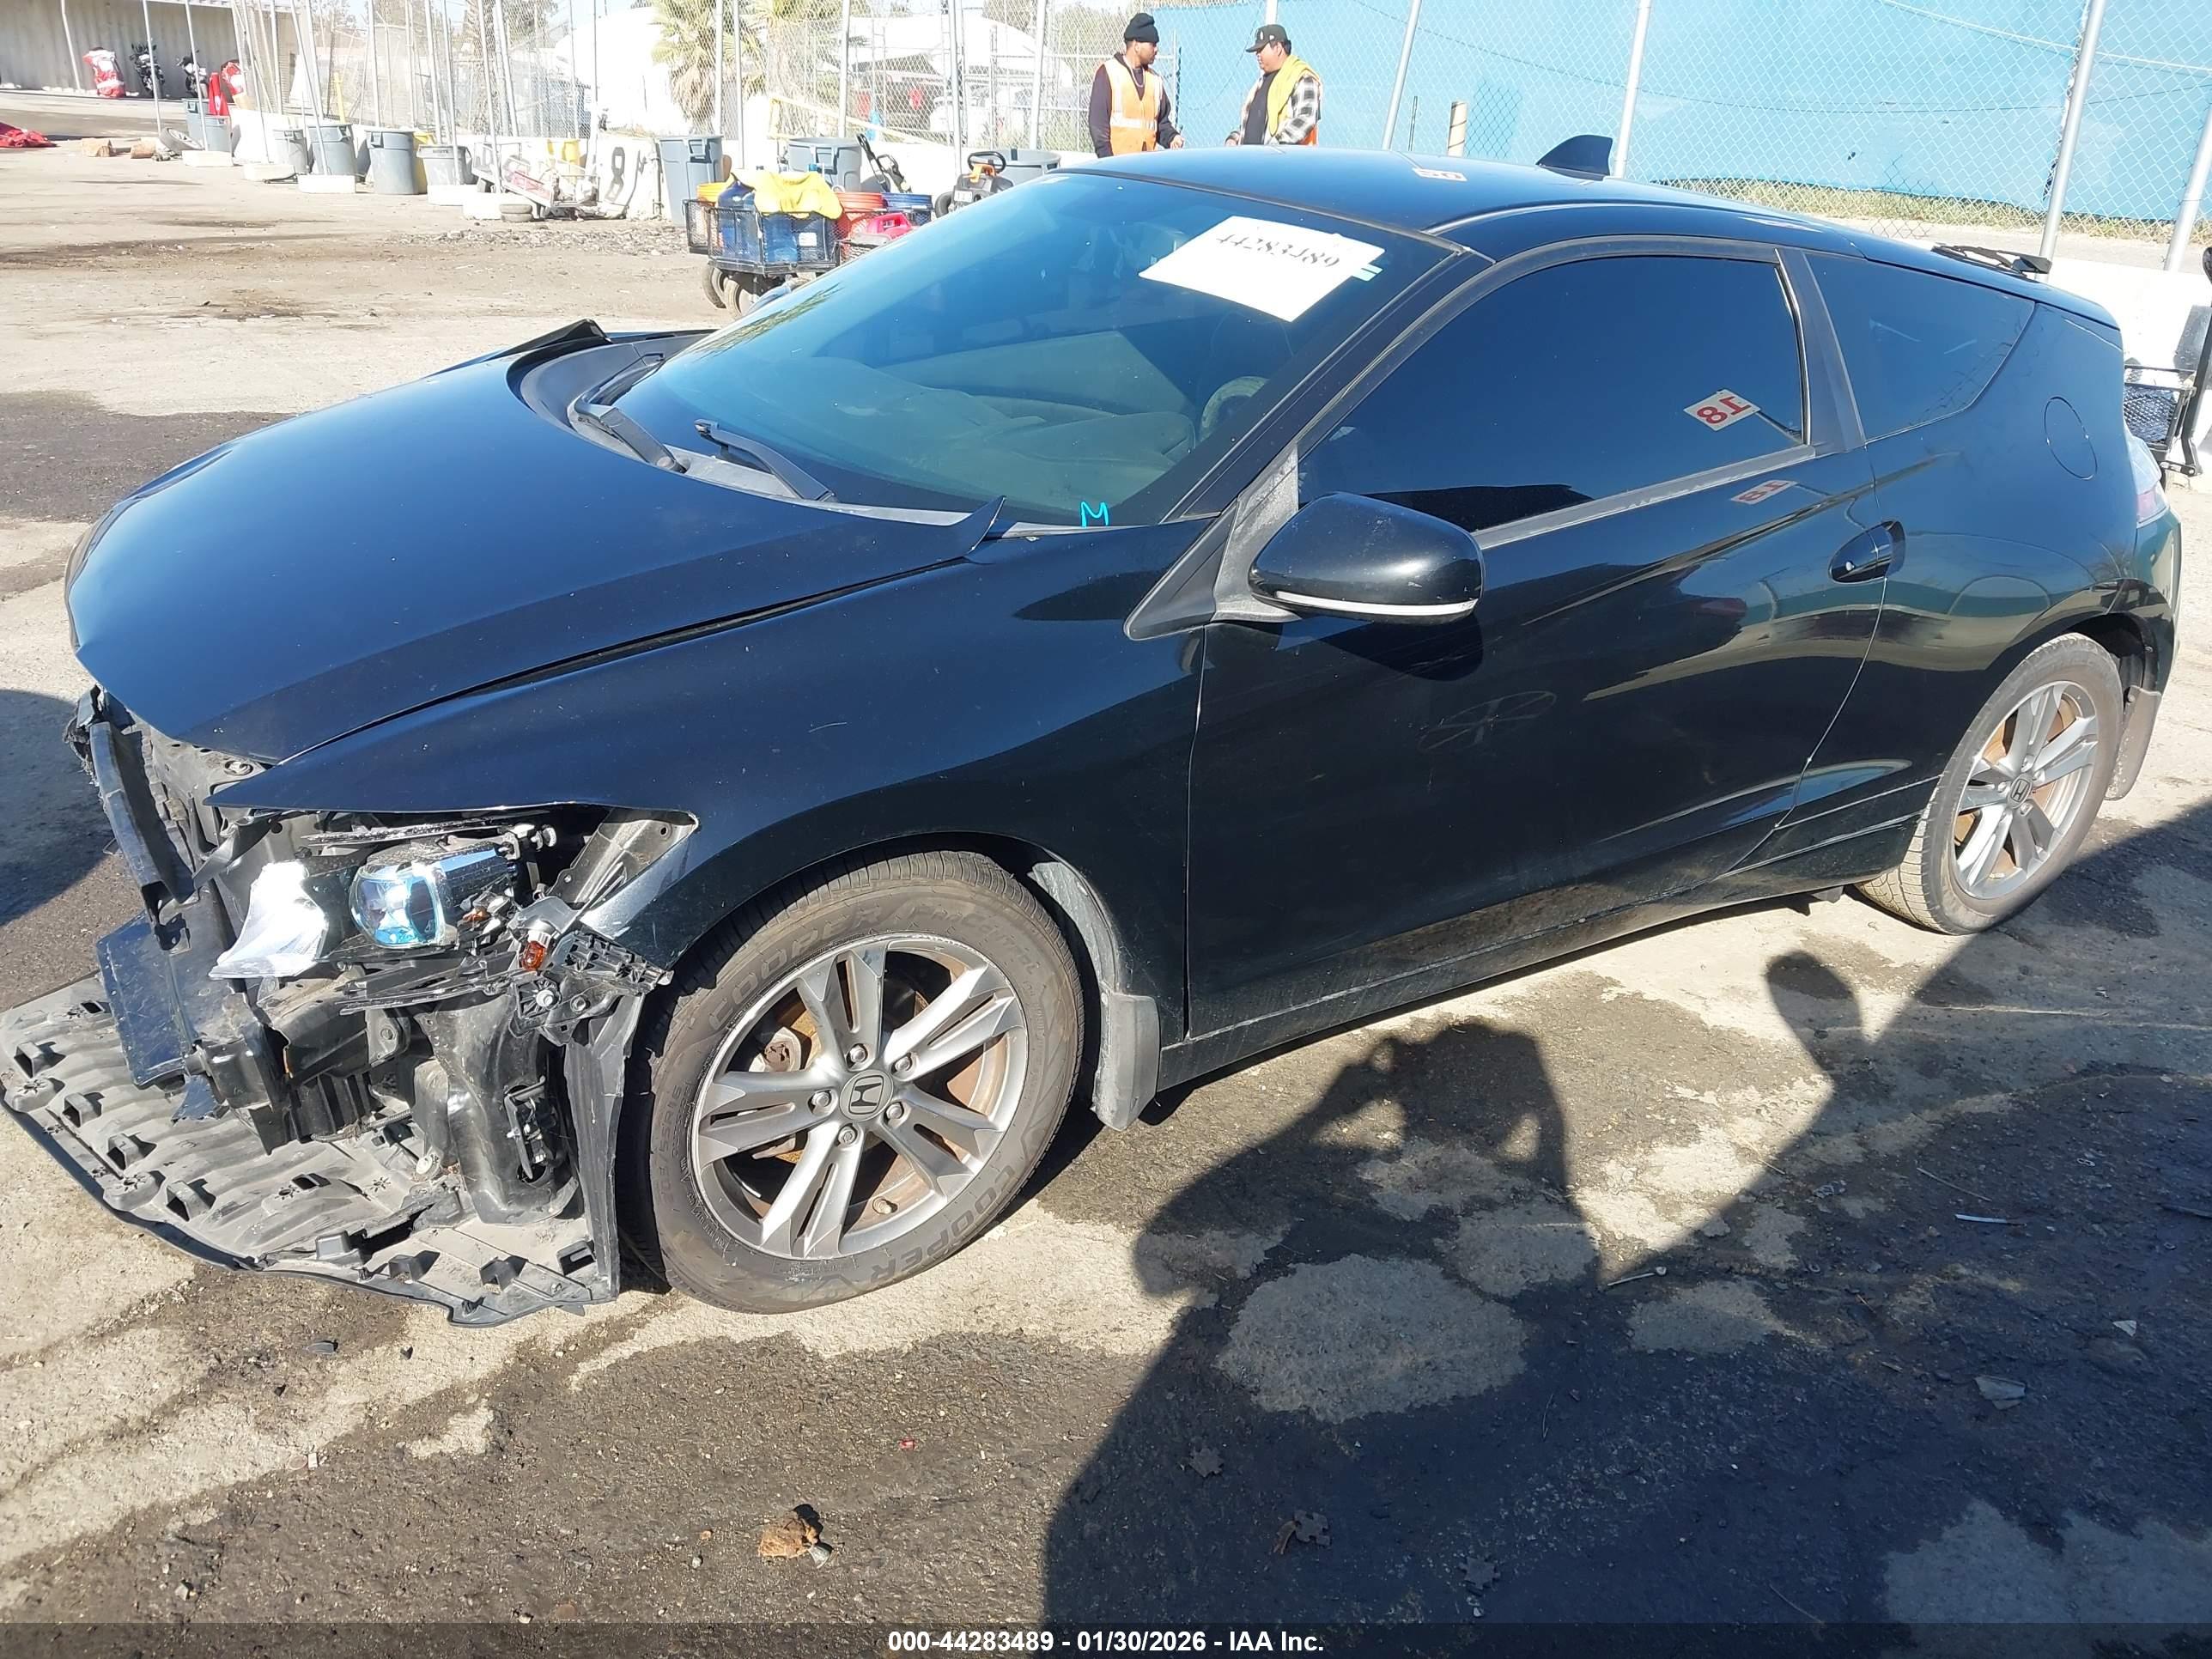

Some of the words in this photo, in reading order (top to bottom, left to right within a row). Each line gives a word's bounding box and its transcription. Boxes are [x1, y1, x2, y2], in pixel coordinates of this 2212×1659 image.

[1080, 501, 1109, 529] M
[708, 905, 882, 1030] COOPER
[870, 1164, 1017, 1284] COOPER
